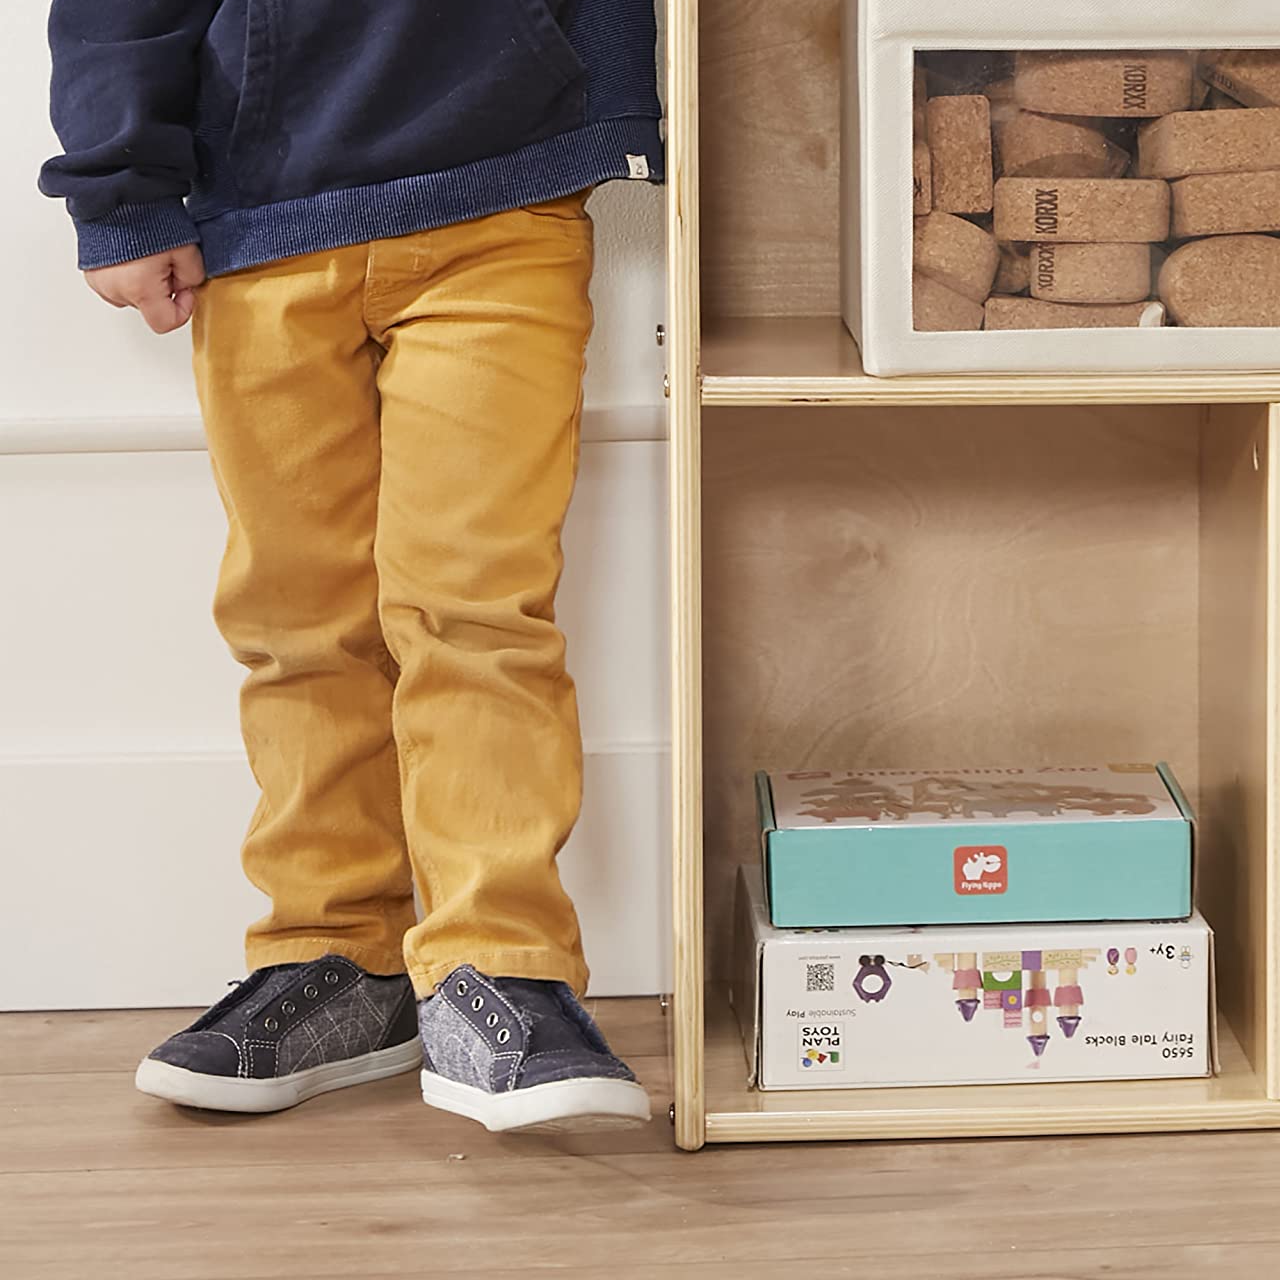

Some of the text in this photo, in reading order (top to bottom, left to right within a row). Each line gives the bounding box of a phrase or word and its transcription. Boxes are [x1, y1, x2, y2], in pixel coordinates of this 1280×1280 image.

[1123, 65, 1147, 110] KORXX
[1035, 188, 1058, 235] KORXX
[1149, 943, 1175, 959] 3y+
[786, 1008, 856, 1018] Sustainable Play
[802, 1026, 840, 1036] TOYS
[802, 1037, 840, 1047] PLAN
[1085, 1032, 1193, 1047] Fairy Tale Blocks
[1162, 1047, 1194, 1058] 5650
